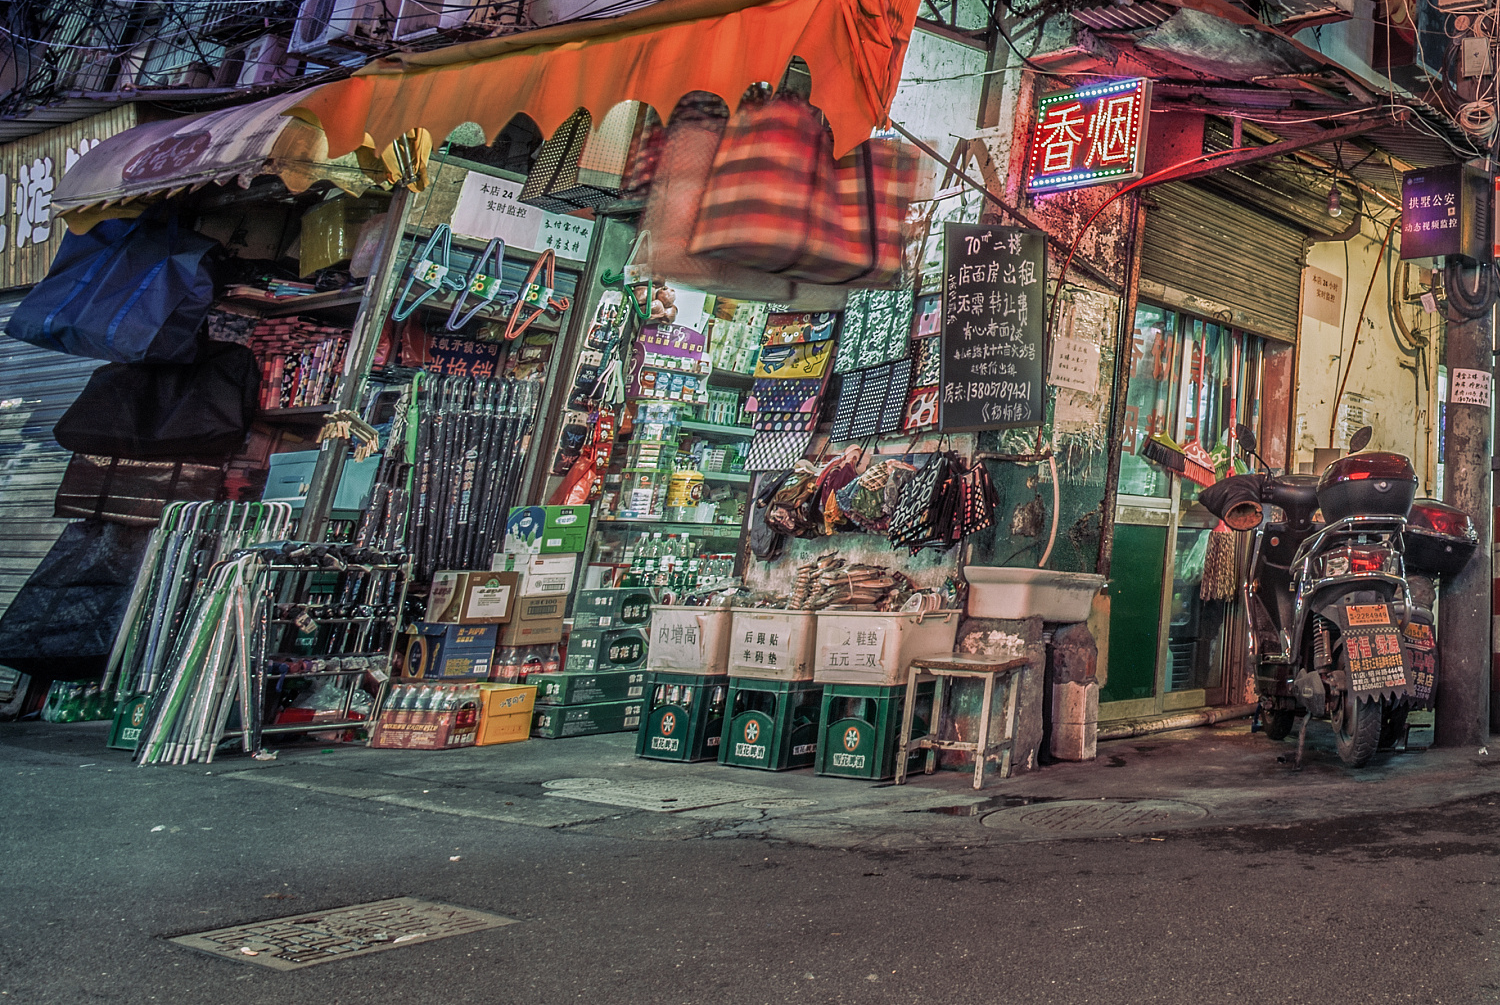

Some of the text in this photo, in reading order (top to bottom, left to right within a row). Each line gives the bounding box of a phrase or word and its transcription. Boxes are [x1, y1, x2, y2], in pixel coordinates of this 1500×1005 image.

[1041, 96, 1134, 172] 香烟
[480, 183, 513, 199] 本店 24
[1409, 193, 1455, 209] 拱墅公安
[486, 200, 527, 219] 实时监控
[1404, 218, 1457, 232] 动态视频监控
[959, 259, 1037, 286] 店面房出租
[963, 318, 1024, 344] 有心者面谈
[623, 606, 640, 618] 雪花
[659, 624, 697, 645] 内增高
[744, 631, 778, 646] 后跟贴
[609, 647, 629, 659] 雪花
[743, 650, 777, 665] 半码垫
[651, 737, 679, 751] 雪花啤酒
[735, 743, 765, 759] 雪花啤酒
[833, 753, 865, 768] 雪花啤酒
